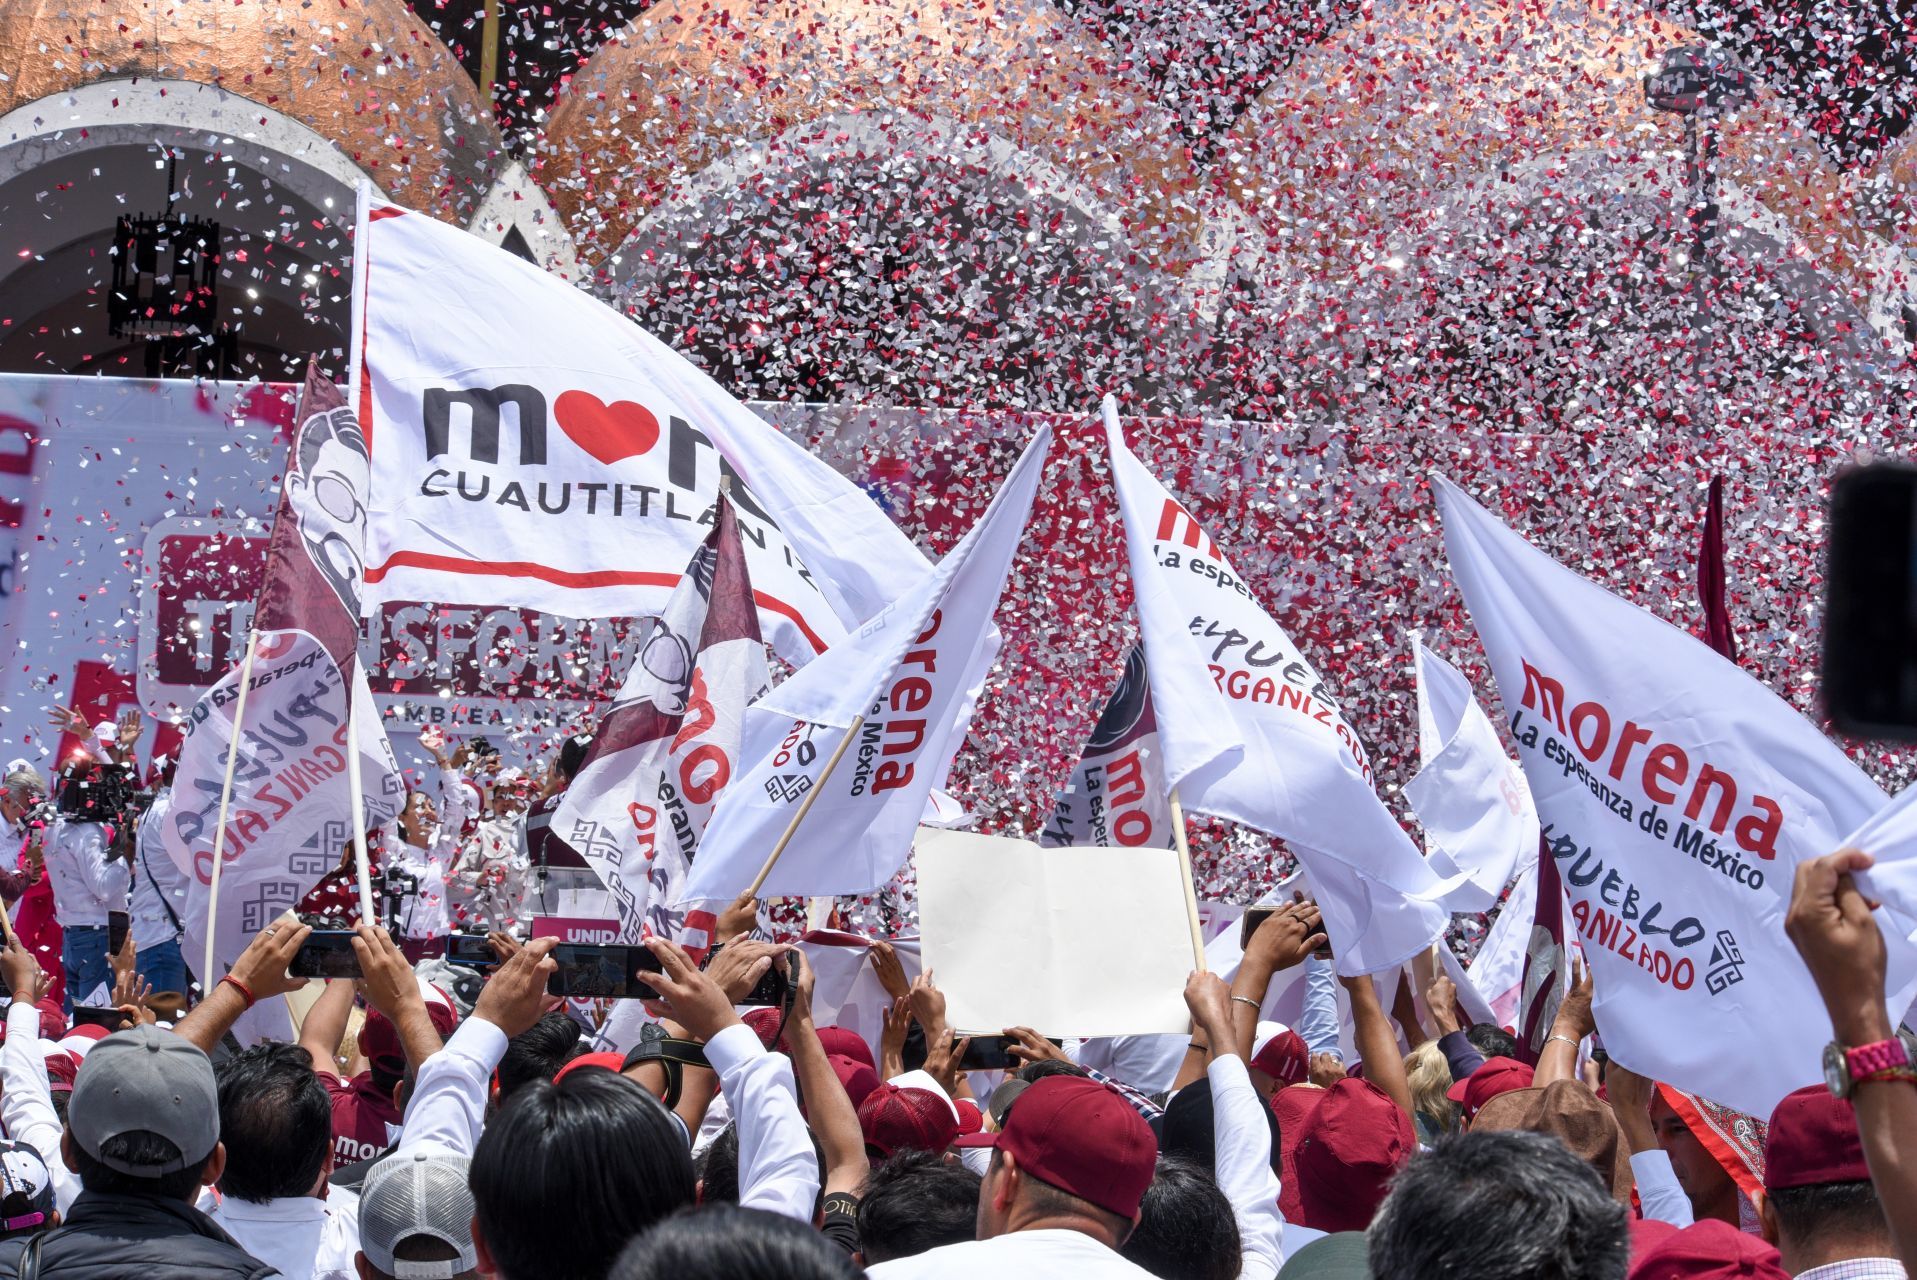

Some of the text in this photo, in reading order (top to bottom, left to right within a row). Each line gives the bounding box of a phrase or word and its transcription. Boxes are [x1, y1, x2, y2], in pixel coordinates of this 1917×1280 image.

[850, 722, 883, 797] México
[1084, 765, 1103, 793] La
[1511, 710, 1539, 749] La
[1543, 736, 1632, 822] esperanza
[1639, 804, 1668, 840] de
[1673, 821, 1764, 890] México
[1521, 656, 1784, 861] morena
